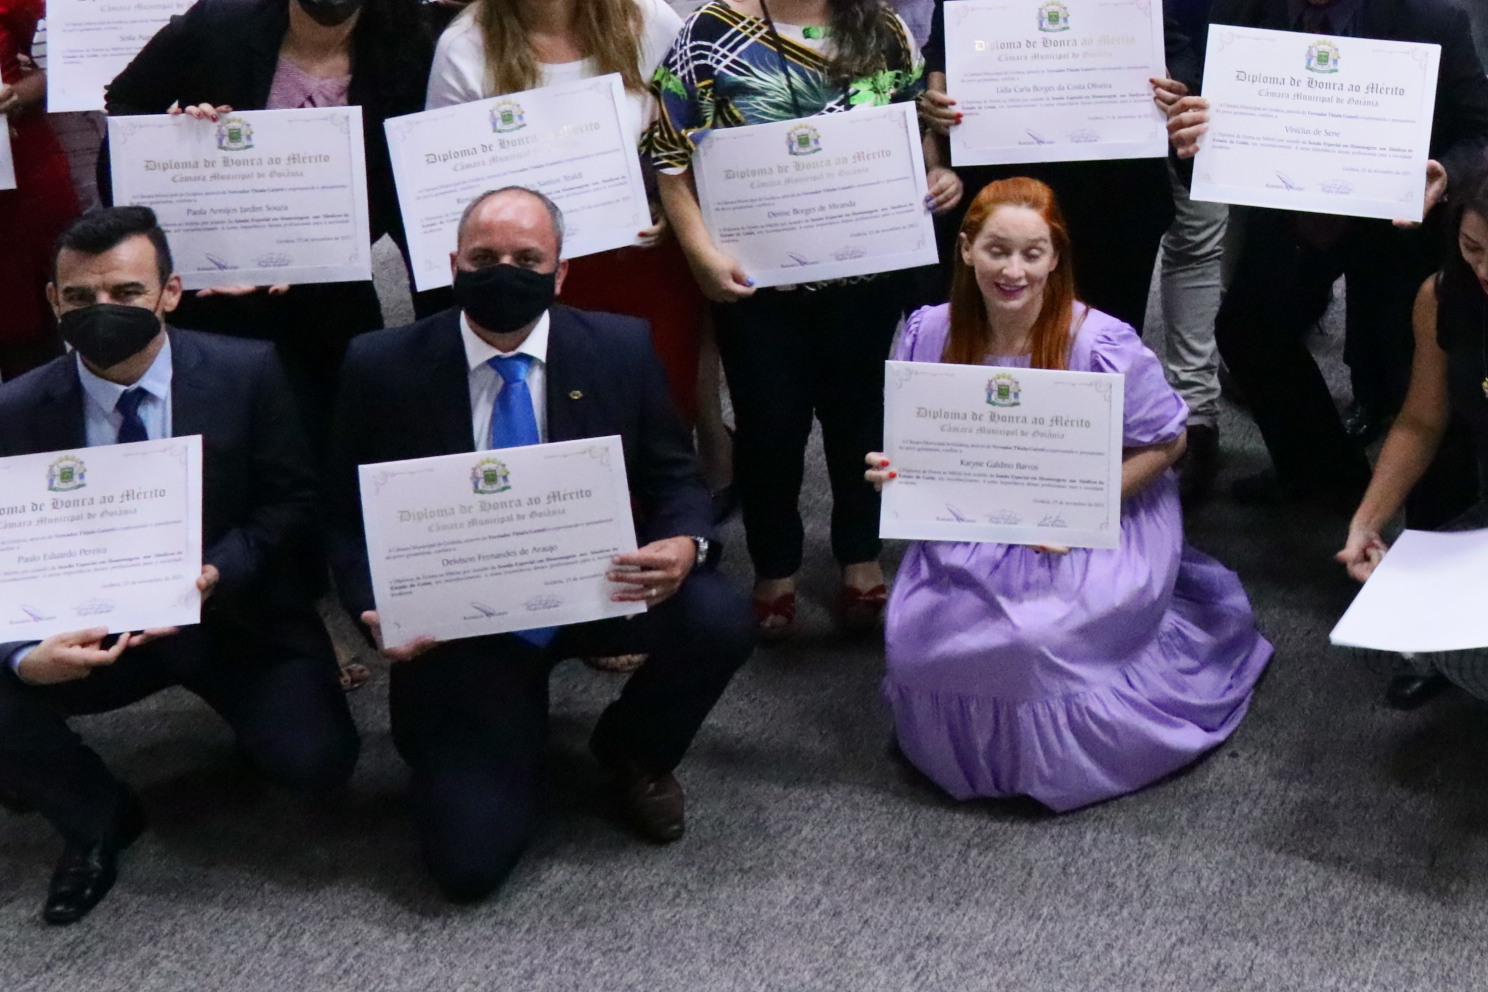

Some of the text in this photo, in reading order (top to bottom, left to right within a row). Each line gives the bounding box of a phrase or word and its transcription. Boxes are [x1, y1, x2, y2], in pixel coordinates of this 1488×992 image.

[973, 39, 1022, 52] Dploma
[1032, 84, 1055, 94] Borges
[1066, 82, 1085, 90] Costa
[1087, 81, 1111, 89] Oliveira
[1234, 69, 1405, 96] Diploma de Honra ao Mérito
[1257, 88, 1378, 107] Câmara Municipal de Goiânia
[1312, 128, 1322, 136] de
[1323, 129, 1340, 137] Sene
[143, 151, 330, 172] Diploma de Honra ao Mérito
[722, 149, 892, 180] Diploma de Honra ao Mérito
[817, 203, 826, 211] de
[827, 199, 855, 210] Miranda
[914, 406, 1090, 427] Diploma de Honra ao Mérito
[960, 459, 1038, 470] Karyne Galdino Barros
[30, 486, 166, 512] de Honra ao Mérito
[396, 488, 592, 522] Diploma de Honra ao Mérito
[17, 546, 106, 563] Paulo Eduardo Pereira
[477, 549, 517, 561] Fernandes
[518, 547, 529, 555] de
